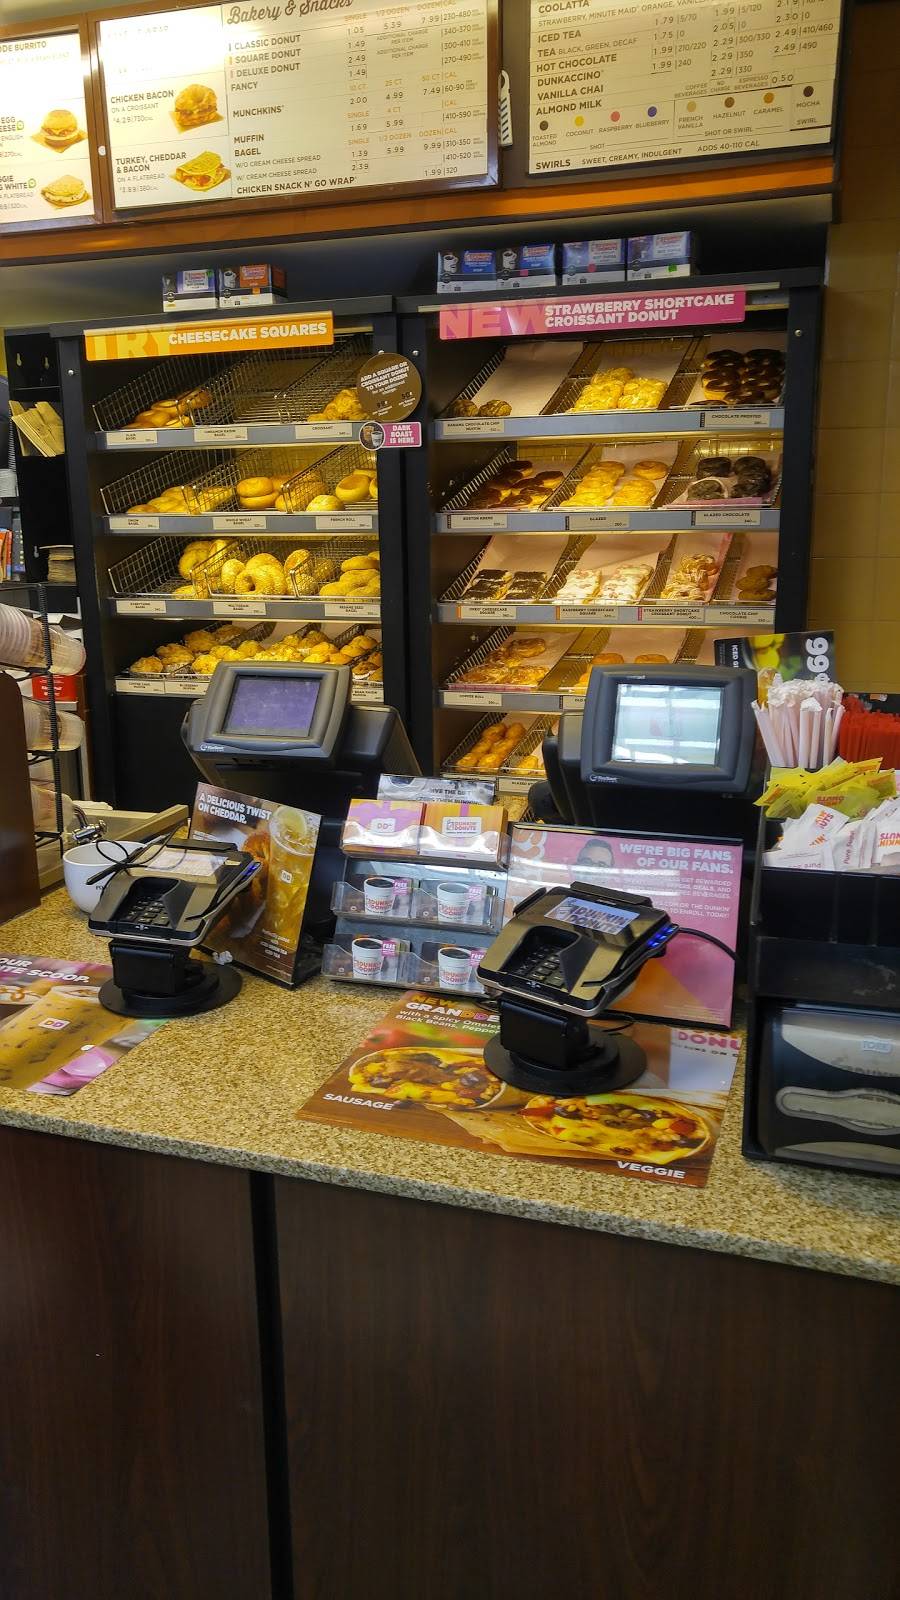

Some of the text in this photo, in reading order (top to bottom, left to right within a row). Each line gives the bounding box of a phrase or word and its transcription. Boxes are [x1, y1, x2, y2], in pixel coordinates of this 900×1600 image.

[227, 6, 282, 25] Bakery
[284, 0, 296, 16] &
[538, 0, 590, 14] COOLATTA
[538, 1, 675, 27] STRAWBERRY, MINUTE MAID ORANGE,
[235, 34, 301, 51] CLASSIC DONUT
[538, 30, 582, 44] ICED TEA
[14, 41, 46, 52] BURRITO
[538, 48, 556, 58] TEA
[558, 45, 584, 55] BLACK,
[613, 38, 639, 47] DECAF
[236, 49, 302, 64] SQUARE DONUT
[536, 54, 617, 73] HOT CHOCOLATE
[236, 62, 301, 78] DELUXE DONUT
[538, 70, 601, 87] DUNKACCINO
[231, 82, 258, 92] FANCY
[538, 84, 604, 100] VANILLA CHAI
[110, 90, 174, 104] CHICKEN BACON
[232, 106, 282, 118] MUNCHKINS
[536, 100, 602, 116] ALMOND MILK
[566, 129, 594, 138] COCONUT
[598, 124, 634, 134] RASPBERRY
[636, 120, 670, 129] BLUEBERRY
[712, 111, 746, 120] HAZELNUT
[753, 106, 784, 116] CARAMEL
[234, 134, 264, 144] MUFFIN
[704, 129, 722, 137] SHOT
[722, 128, 732, 136] OR
[733, 126, 754, 134] SWIRL
[116, 152, 187, 166] TURKEY, CHEDDAR
[234, 148, 262, 157] BAGEL
[272, 157, 296, 165] CHEESE
[296, 155, 321, 163] SPREAD
[536, 159, 571, 170] SWIRLS
[582, 158, 607, 166] SWEET,
[609, 154, 640, 163] CREAMY,
[641, 148, 682, 158] INDULGENT
[697, 143, 718, 152] ADDS
[745, 140, 760, 149] CAL
[116, 164, 150, 174] & BACON
[268, 170, 292, 178] CHEESE
[293, 168, 317, 176] SPREAD
[5, 183, 28, 192] WHITE
[237, 185, 272, 194] CHICKEN
[274, 182, 302, 191] SNACK
[314, 179, 327, 187] GO
[330, 177, 355, 186] WRAP
[545, 293, 735, 318] STRAWBERRY SHORTCAKE
[443, 302, 546, 339] NEW
[545, 309, 680, 328] CROISSANT DONUT
[168, 323, 328, 346] CHEESECAKE SQUARES
[374, 380, 390, 389] YOUR
[392, 424, 412, 432] DARK
[198, 802, 247, 825] ON CHEDDAR.
[199, 792, 272, 824] A DELICIOUS TWIST
[620, 843, 732, 862] WE'RE BIG FANS
[636, 858, 734, 874] OF OUR FANS.
[394, 880, 408, 888] FREE
[695, 878, 732, 887] REWARDED
[27, 969, 90, 983] SCOOP.
[411, 994, 457, 1008] NEW
[395, 1014, 424, 1024] Black
[398, 1010, 422, 1020] with
[432, 1014, 460, 1024] Spicy
[323, 1093, 394, 1112] SAUSAGE
[616, 1160, 686, 1180] VEGGIE
